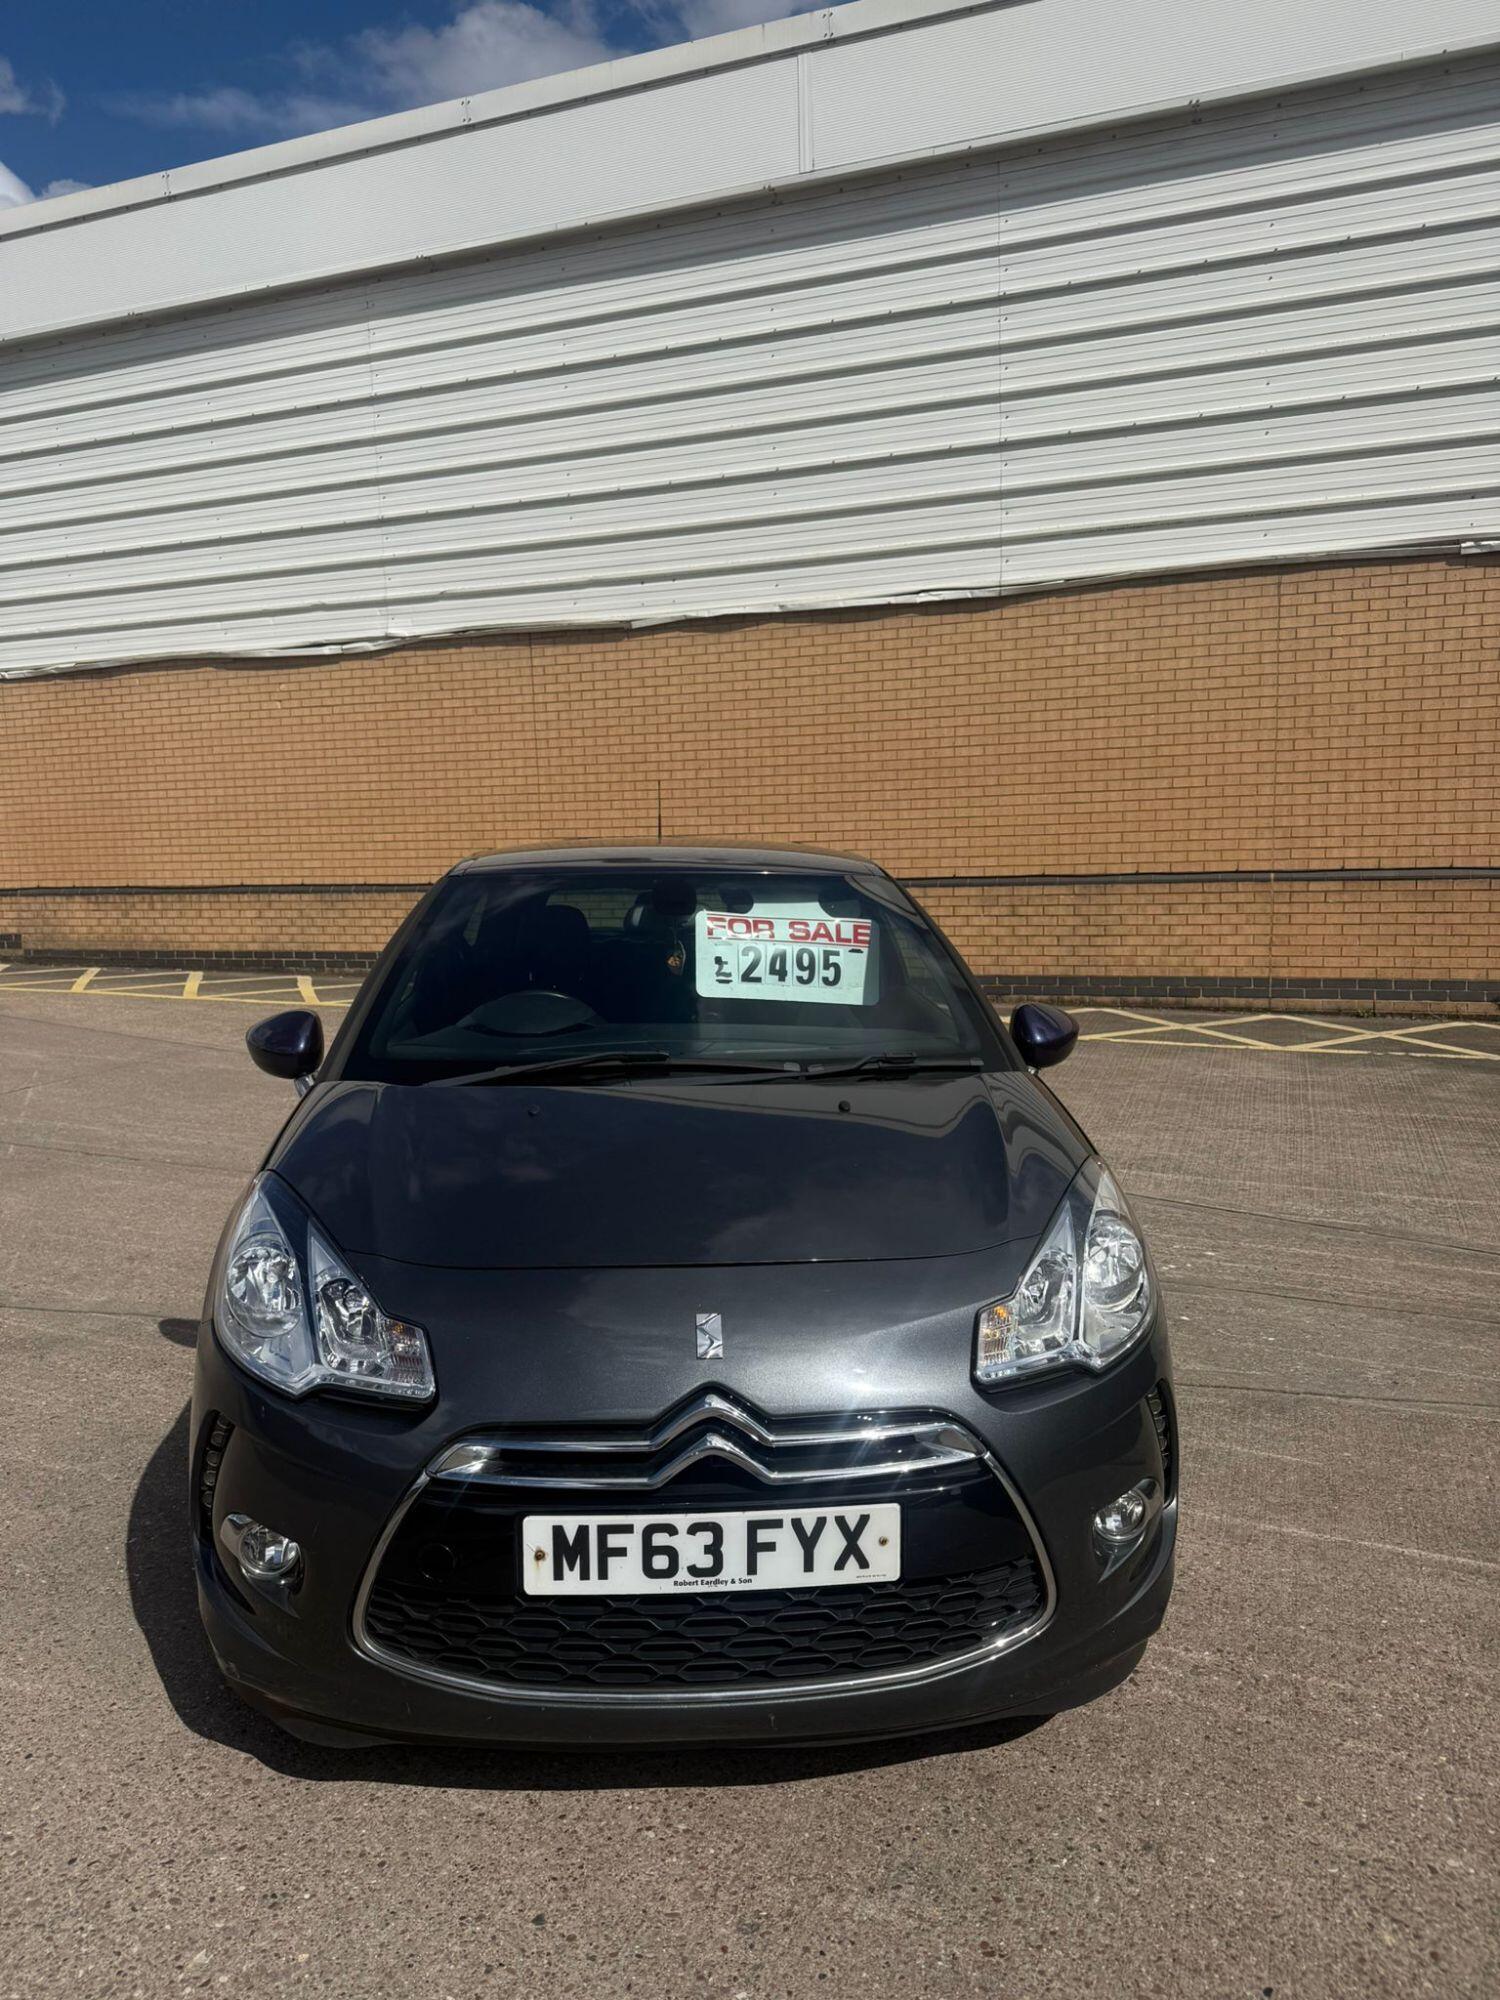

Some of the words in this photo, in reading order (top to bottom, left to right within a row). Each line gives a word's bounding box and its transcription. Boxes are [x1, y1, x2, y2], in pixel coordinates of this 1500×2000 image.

[706, 917, 775, 939] FOR
[789, 921, 871, 945] SALE
[552, 1522, 724, 1582] MF63
[746, 1514, 871, 1576] FYX
[701, 1578, 728, 1586] Eardley
